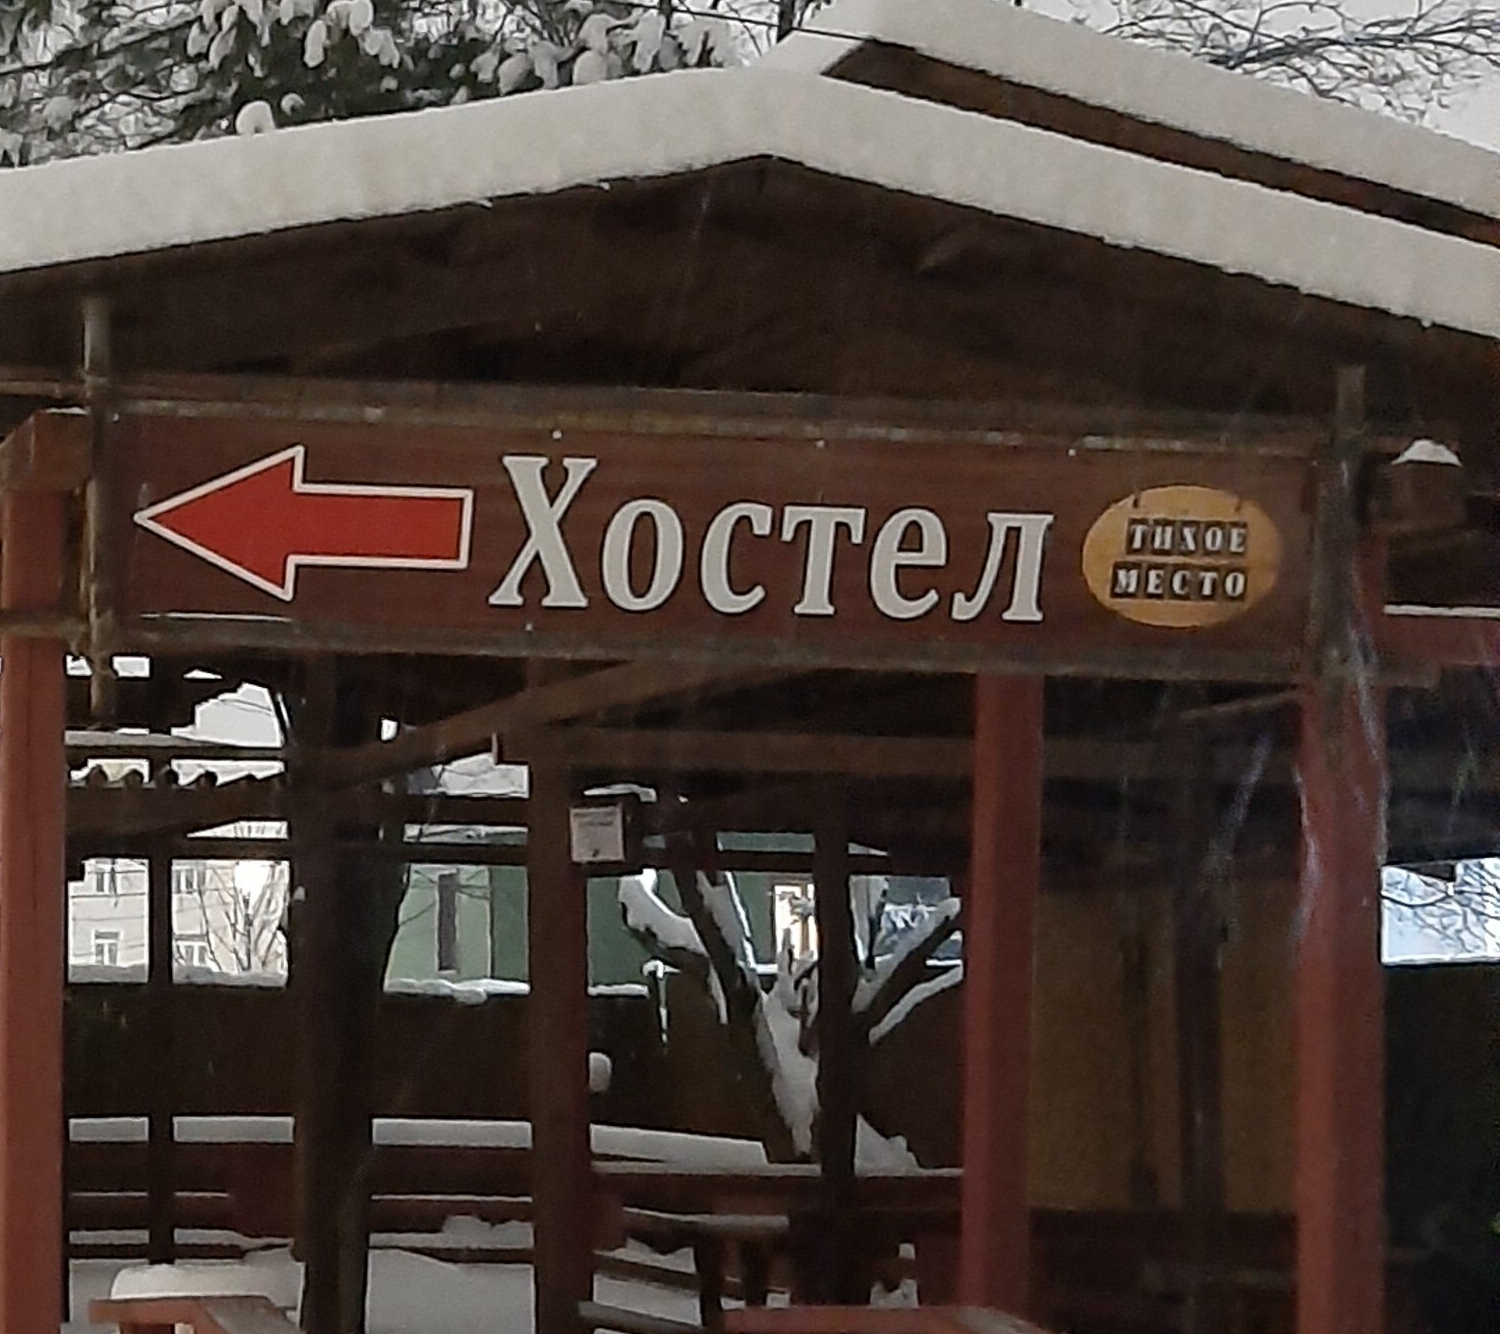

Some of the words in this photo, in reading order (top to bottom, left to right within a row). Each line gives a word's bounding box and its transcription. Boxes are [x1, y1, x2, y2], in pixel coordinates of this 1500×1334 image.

[488, 455, 1055, 622] Хостел
[1130, 523, 1247, 553] ТИХОЕ
[1113, 568, 1246, 598] МЕСТО
